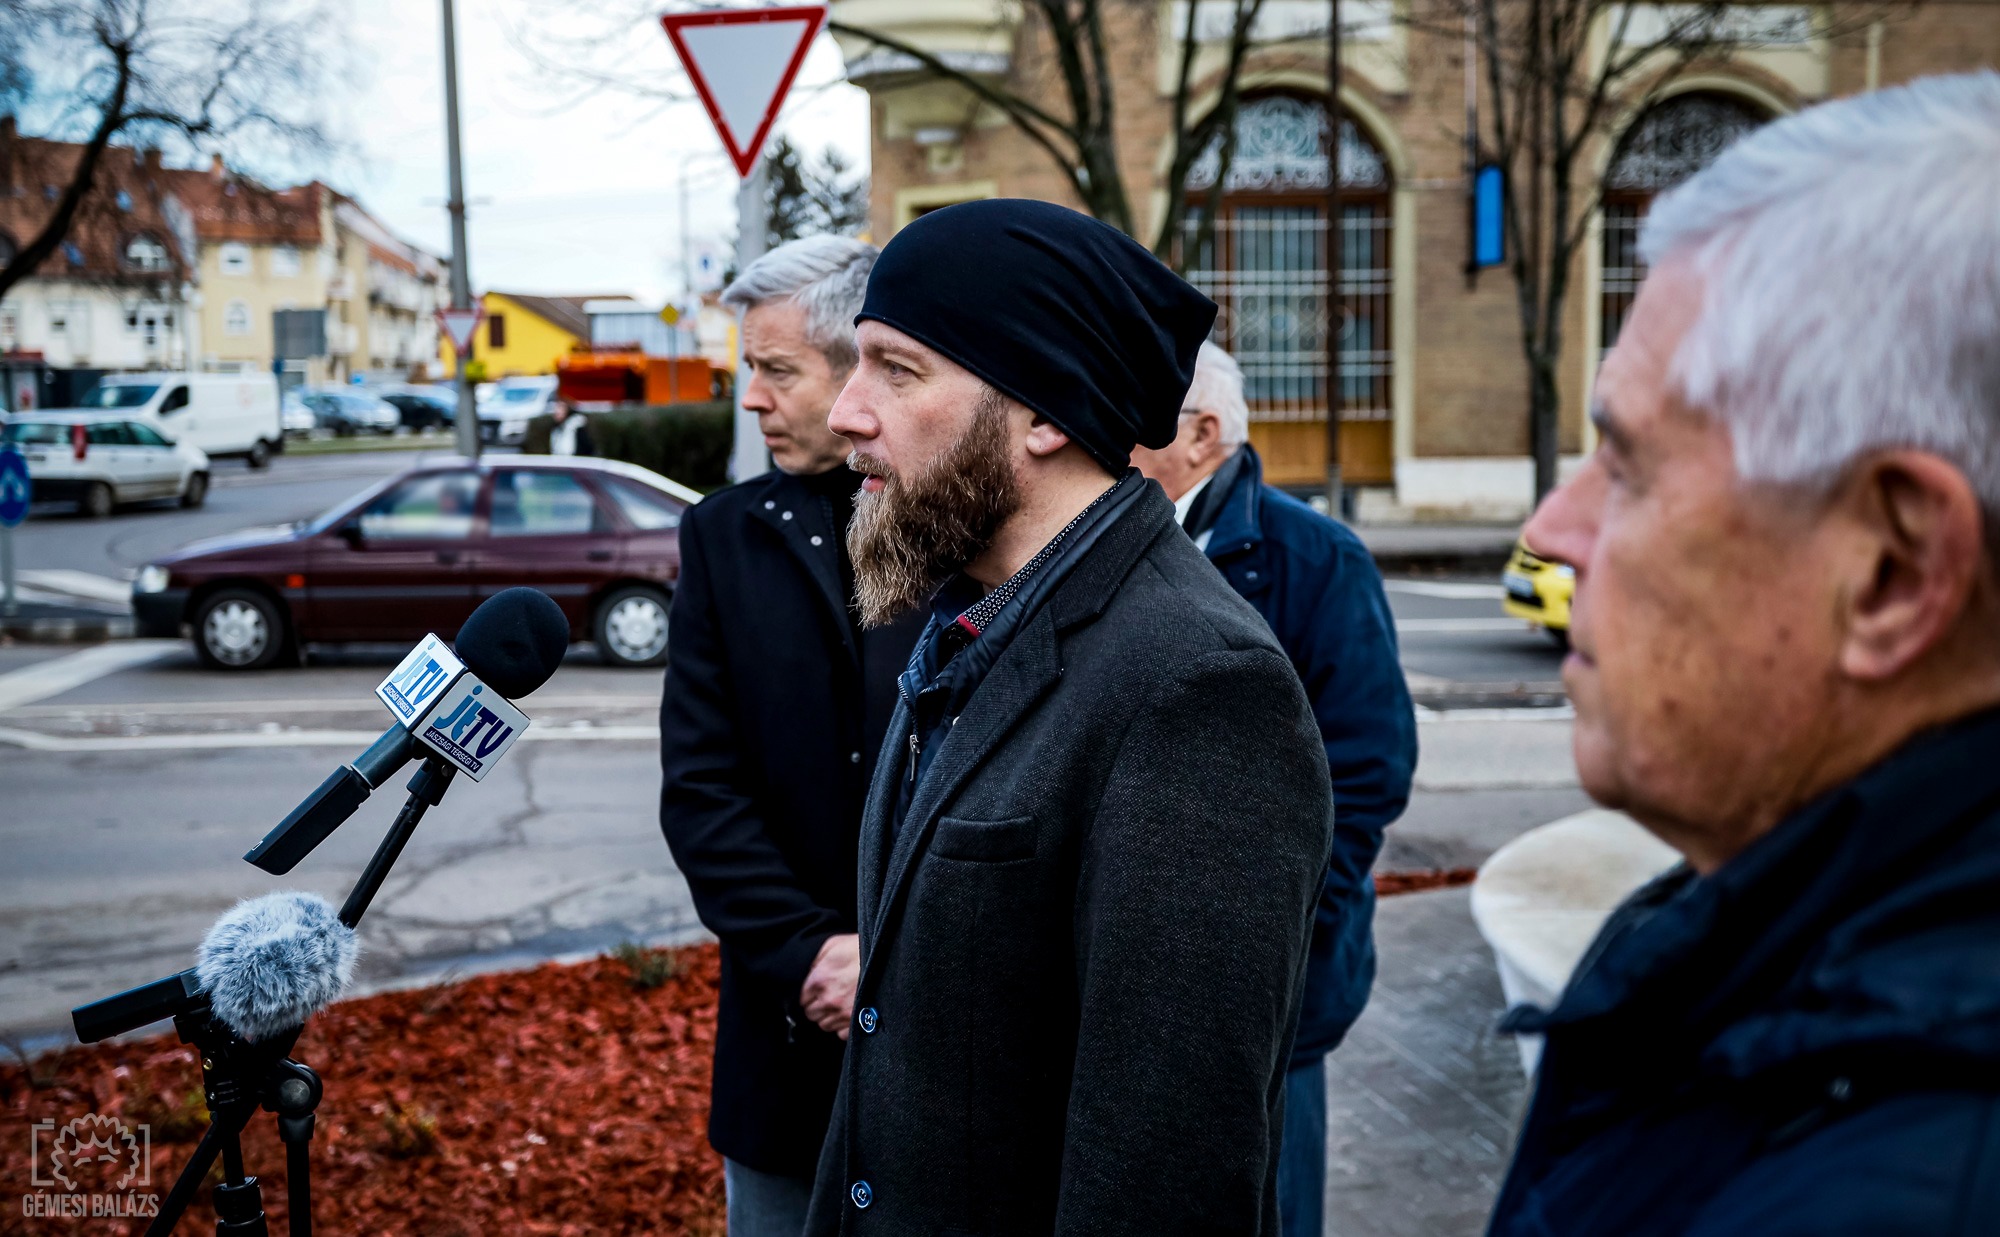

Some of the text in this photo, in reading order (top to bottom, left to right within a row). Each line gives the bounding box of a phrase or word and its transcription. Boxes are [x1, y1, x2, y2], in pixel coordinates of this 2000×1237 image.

[425, 730, 480, 770] JÁSZSÁGI TÉRSÉGI TV
